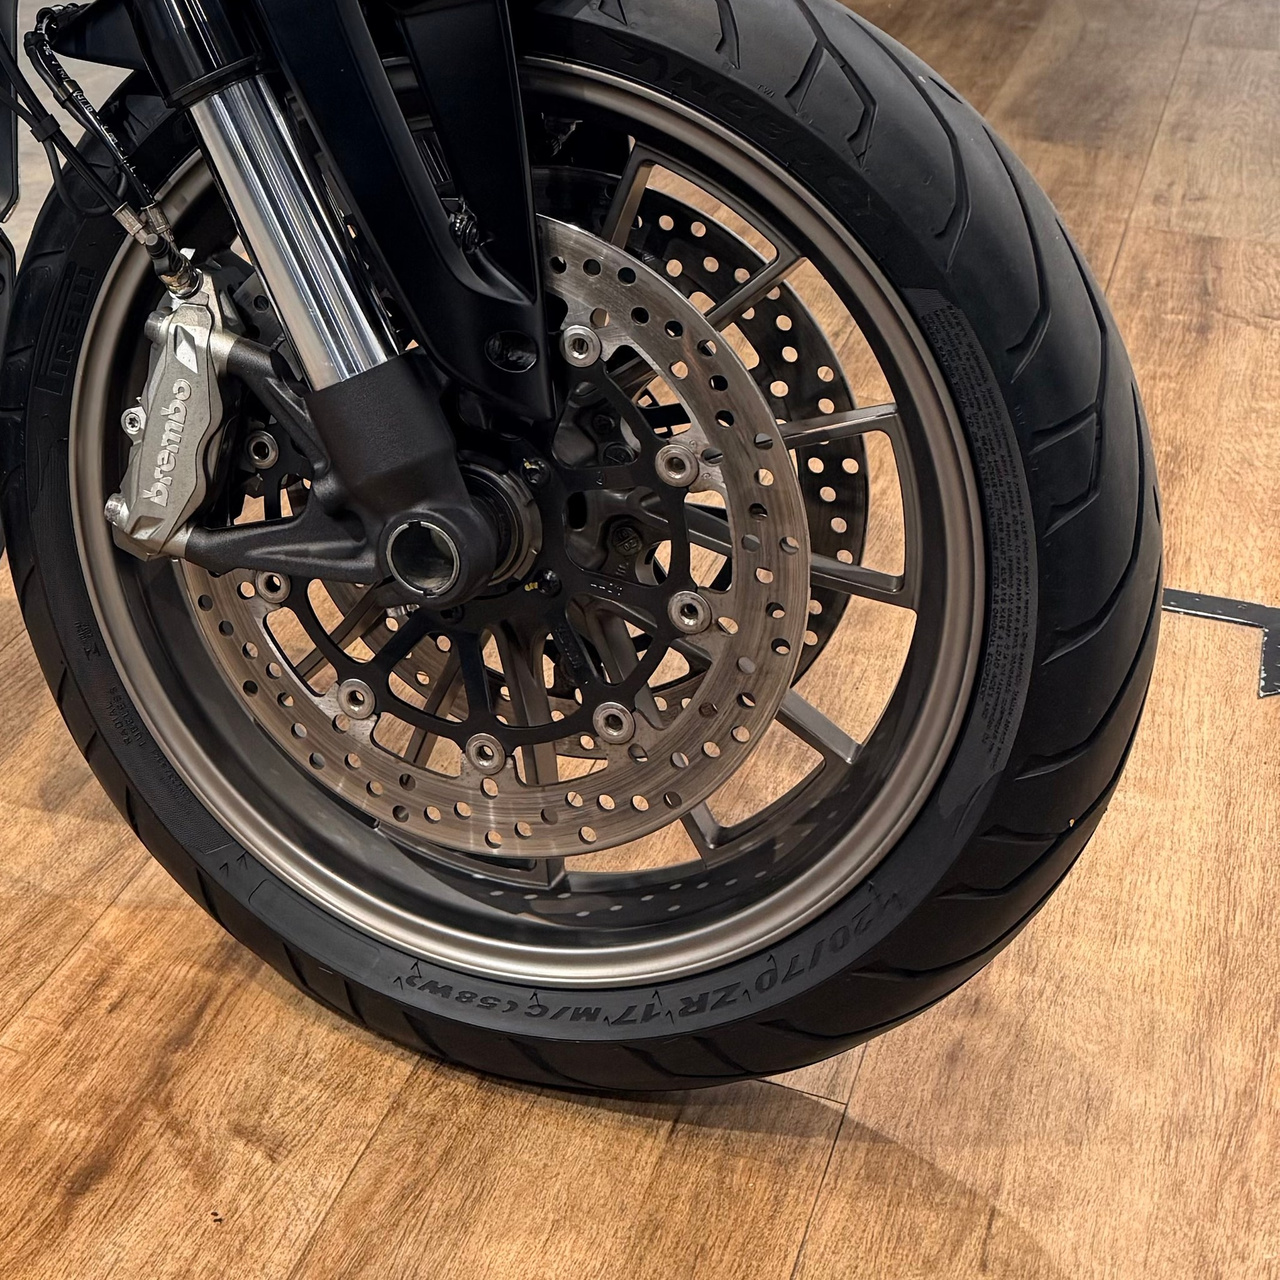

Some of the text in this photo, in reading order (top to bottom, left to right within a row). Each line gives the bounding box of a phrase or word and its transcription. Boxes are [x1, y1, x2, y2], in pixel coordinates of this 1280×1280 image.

[143, 378, 192, 507] brembo
[609, 1000, 662, 1026] 17
[680, 985, 740, 1017] ZR
